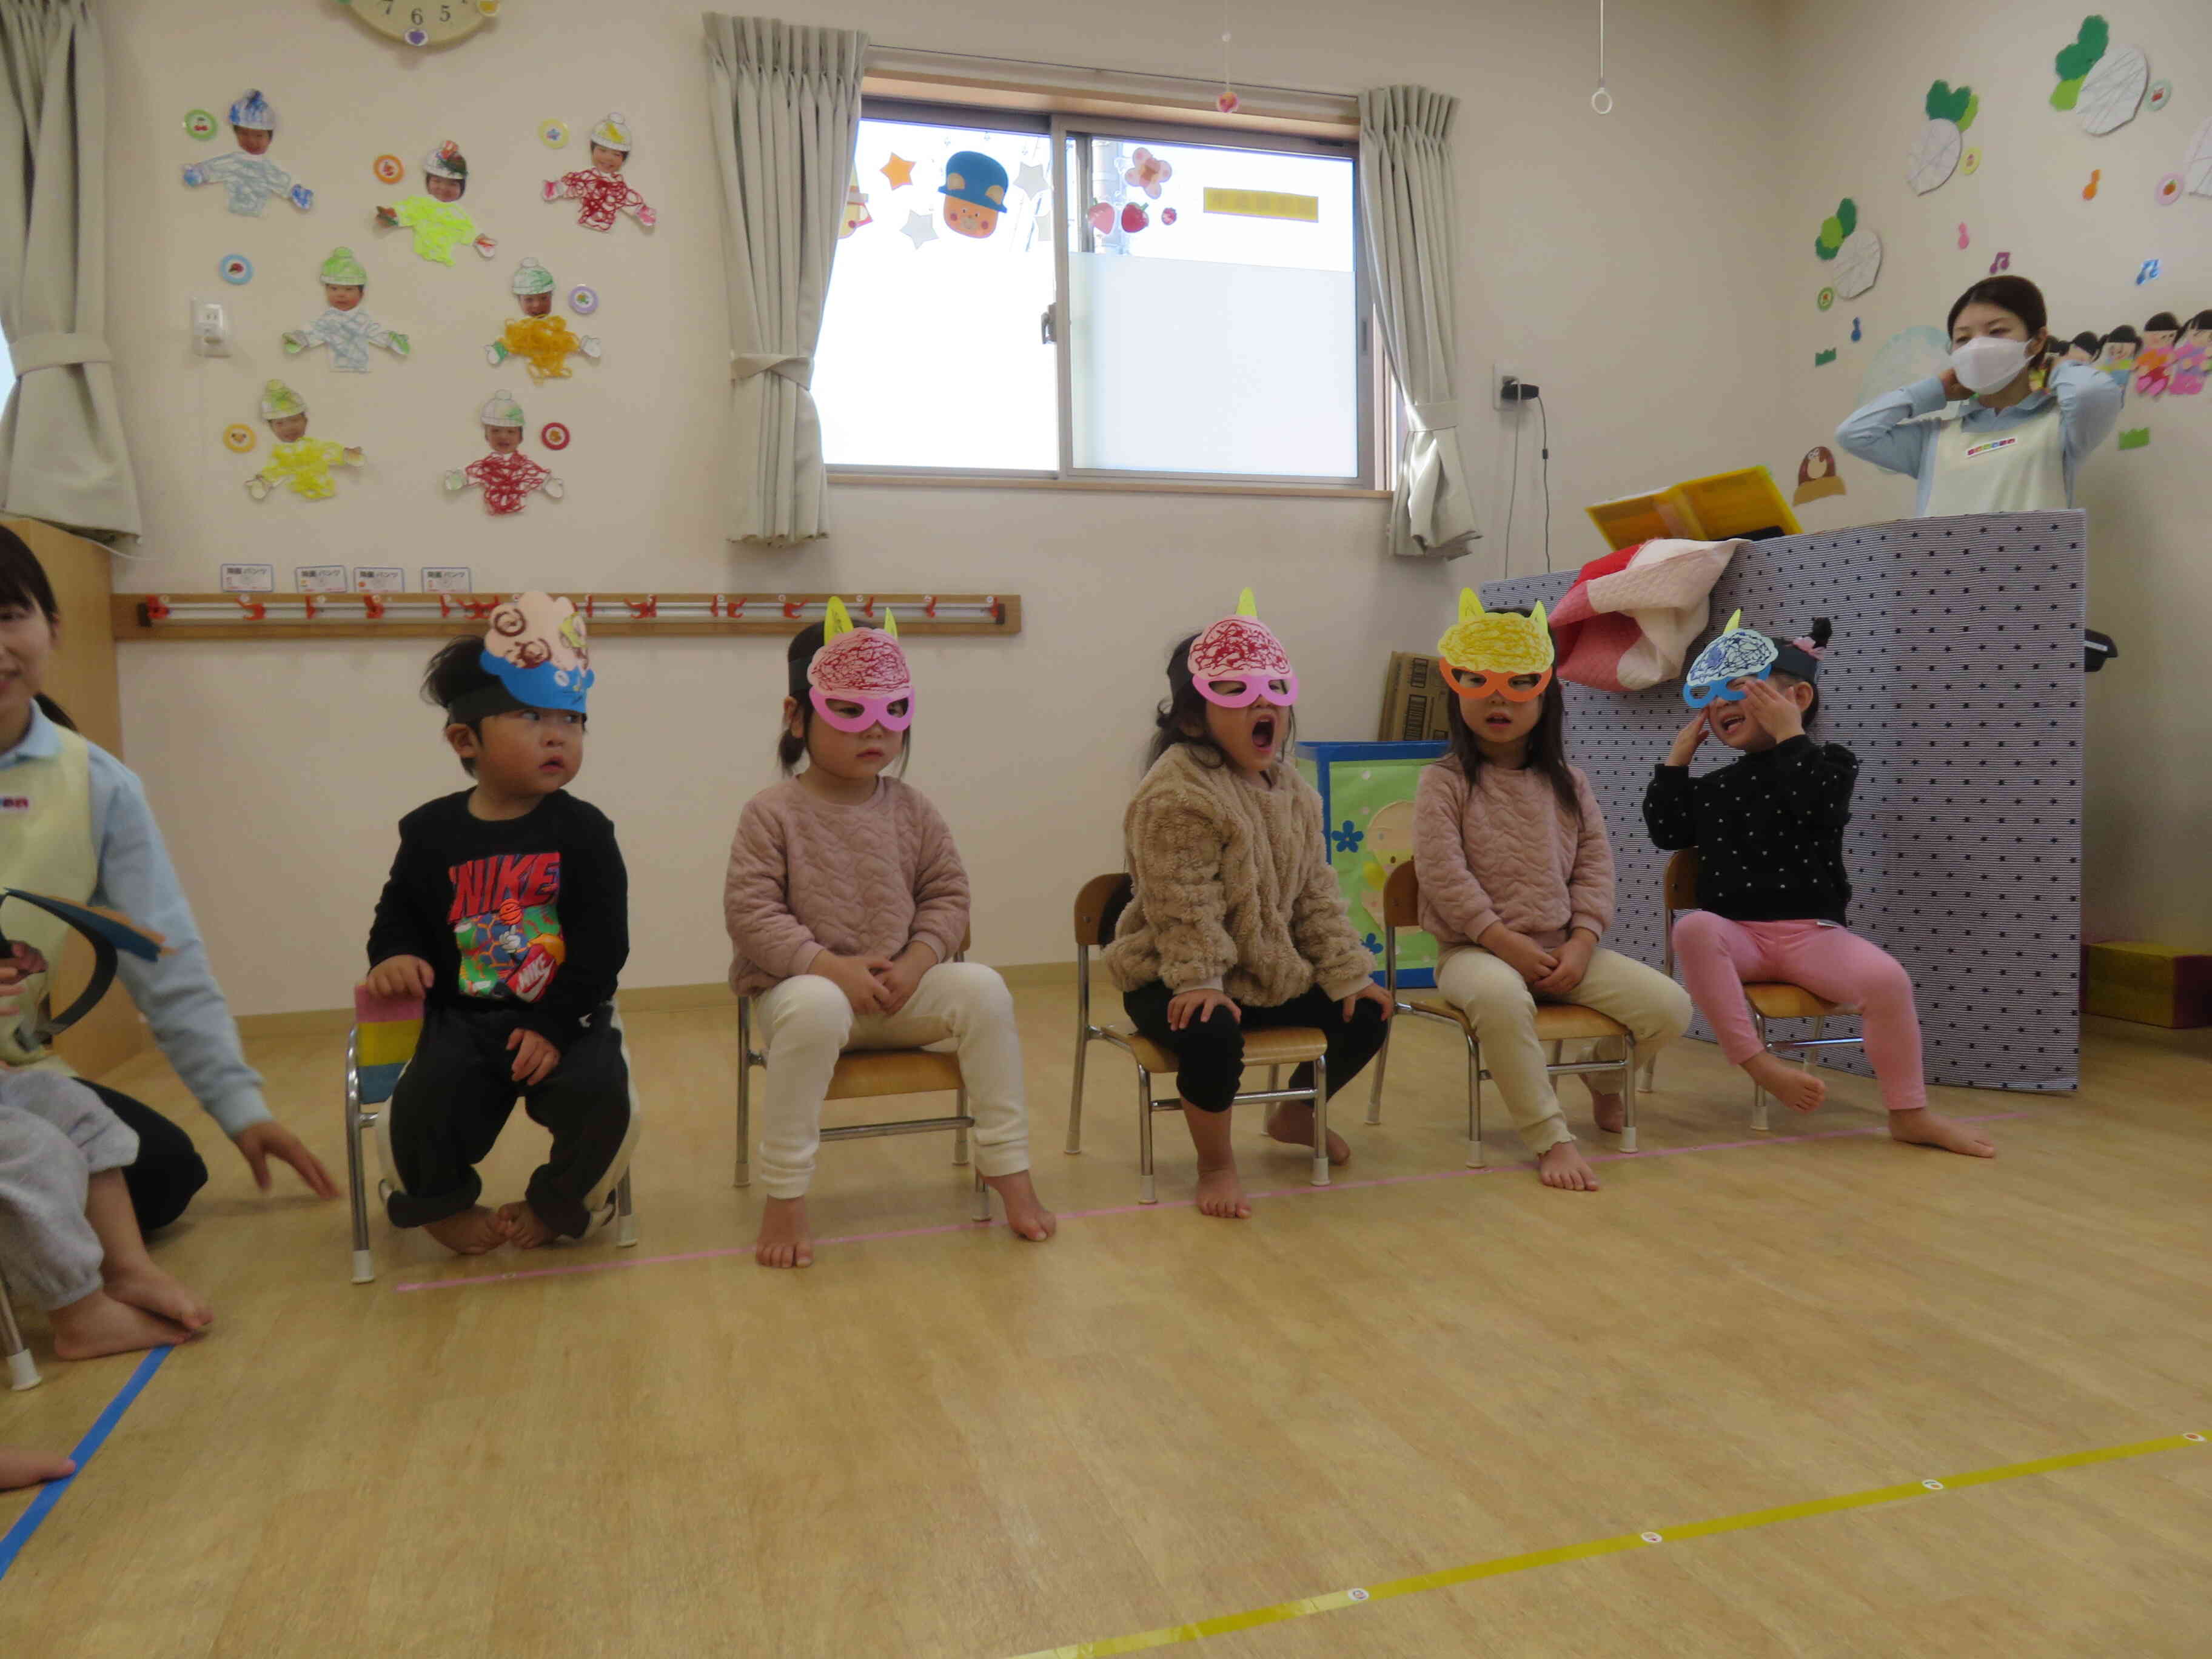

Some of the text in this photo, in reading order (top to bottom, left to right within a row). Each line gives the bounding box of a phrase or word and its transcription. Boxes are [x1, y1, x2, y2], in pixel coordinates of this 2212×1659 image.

[379, 0, 394, 15] 7
[411, 7, 424, 25] 6
[439, 5, 451, 22] 5
[447, 852, 561, 922] NIKE
[518, 953, 547, 990] NIKE
